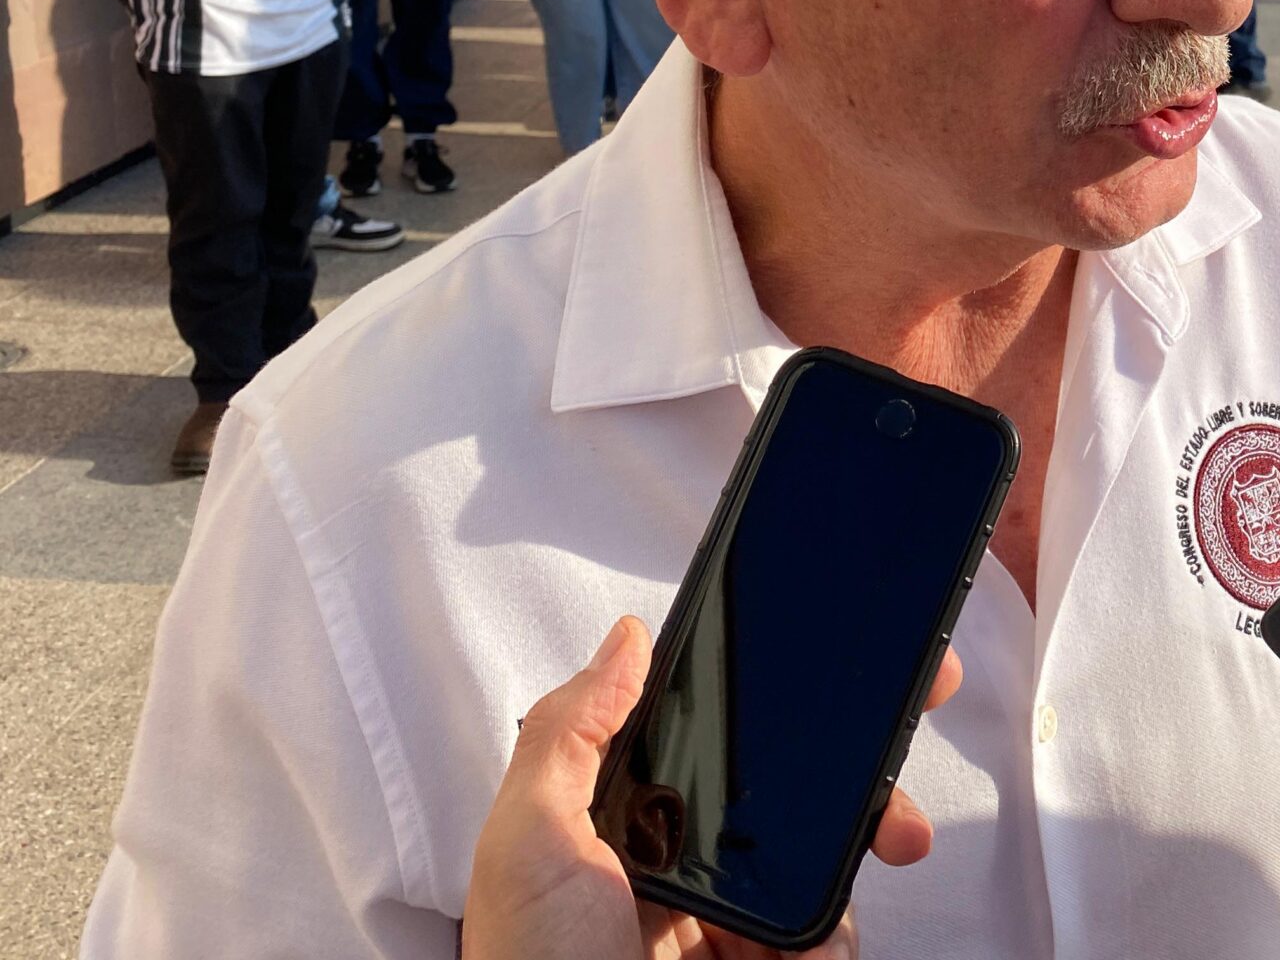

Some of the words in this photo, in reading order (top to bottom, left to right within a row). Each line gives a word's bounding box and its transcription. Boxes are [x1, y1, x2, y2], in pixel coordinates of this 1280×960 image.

[1206, 405, 1235, 432] LIBRE
[1236, 401, 1244, 418] Y
[1179, 426, 1209, 472] ESTADO
[1175, 476, 1190, 499] DEL
[1176, 504, 1202, 577] CONGRESO
